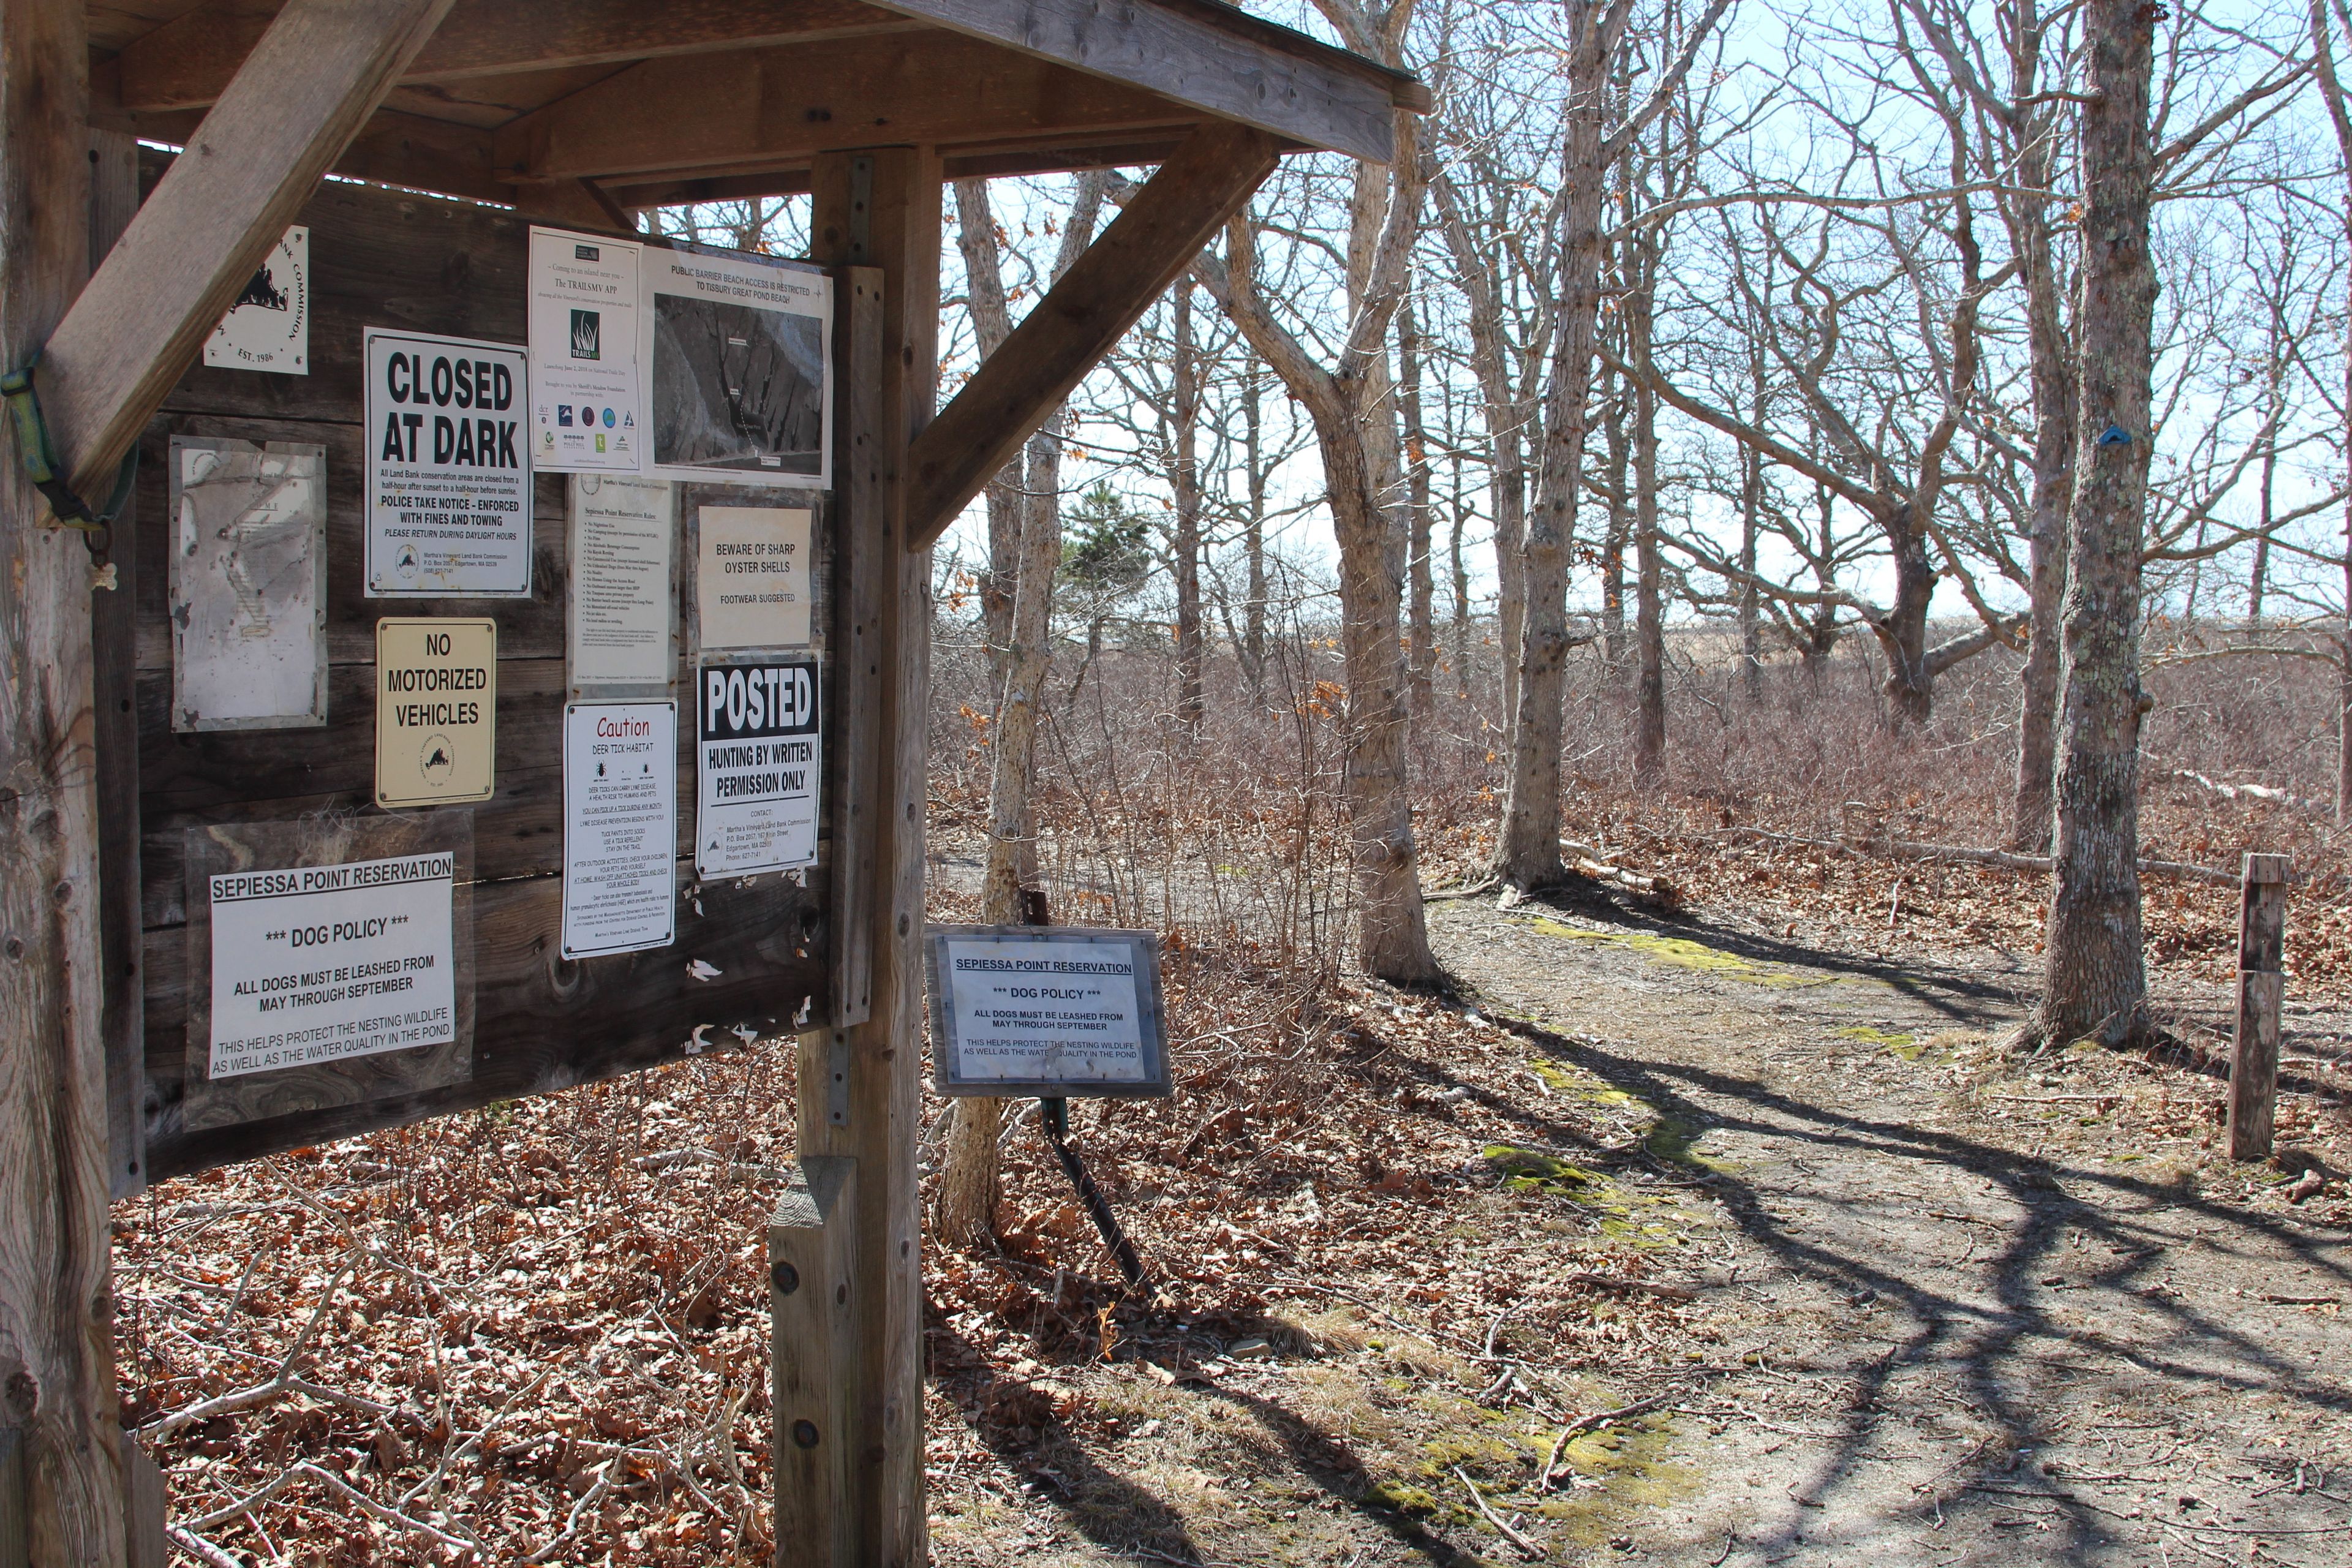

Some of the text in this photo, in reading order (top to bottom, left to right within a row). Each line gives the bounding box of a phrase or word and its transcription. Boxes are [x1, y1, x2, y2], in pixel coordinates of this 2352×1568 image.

[552, 263, 570, 274] Coming
[584, 268, 598, 276] island
[279, 239, 304, 341] ANK COMMISSION
[555, 278, 617, 293] The TRAILSMV APP
[671, 265, 810, 296] PUBLIC BARRIER BEACH ACCESS IS RESTRICTED
[696, 281, 704, 290] TO
[706, 282, 731, 294] TISBURY
[732, 287, 752, 297] GREAT
[753, 290, 769, 300] POND
[238, 349, 273, 363] EST. 1986
[388, 352, 512, 410] CLOSED
[382, 412, 518, 468] AT DARK
[382, 481, 407, 491] half-hour
[484, 474, 502, 483] closed
[381, 495, 519, 511] POLICE TAKE NOTICE ENFORCED
[585, 507, 604, 516] Sepiessa
[400, 511, 502, 526] WITH FINES AND TOWING
[412, 529, 437, 538] RETURN
[439, 530, 464, 538] DURING
[717, 543, 795, 555] BEWARE OF SHARP
[725, 561, 790, 573] OYSTER SHELLS
[720, 594, 794, 604] FOOTWEAR SUGGESTED
[427, 634, 451, 655] NO
[388, 668, 486, 692] MOTORIZED
[707, 668, 812, 731] POSTED
[396, 703, 478, 726] VEHICLES
[597, 717, 649, 737] Caution
[592, 742, 653, 755] DEER TICK HABITAT
[709, 741, 812, 769] HUNTING BY WRITTEN
[717, 769, 805, 797] PERMISSION ONLY
[750, 809, 772, 817] CONTACT:
[213, 858, 452, 898] SEPIESSA POINT RESERVATION
[292, 917, 387, 947] DOG POLICY
[234, 955, 434, 995] ALL DOGS MUST BE LEASHED FROM
[956, 959, 1131, 973] SEPIESSA POINT RESERVATION
[260, 976, 413, 1011] MAY THROUGH SEPTEMBER
[1011, 987, 1083, 999] DOG POLICY
[219, 1007, 447, 1054] THIS HELPS PROTECT THE NESTING WILDLIFE
[212, 1023, 451, 1073] AS WELL AS THE WATER QUALITY IN THE POND.
[1050, 1041, 1065, 1049] THE
